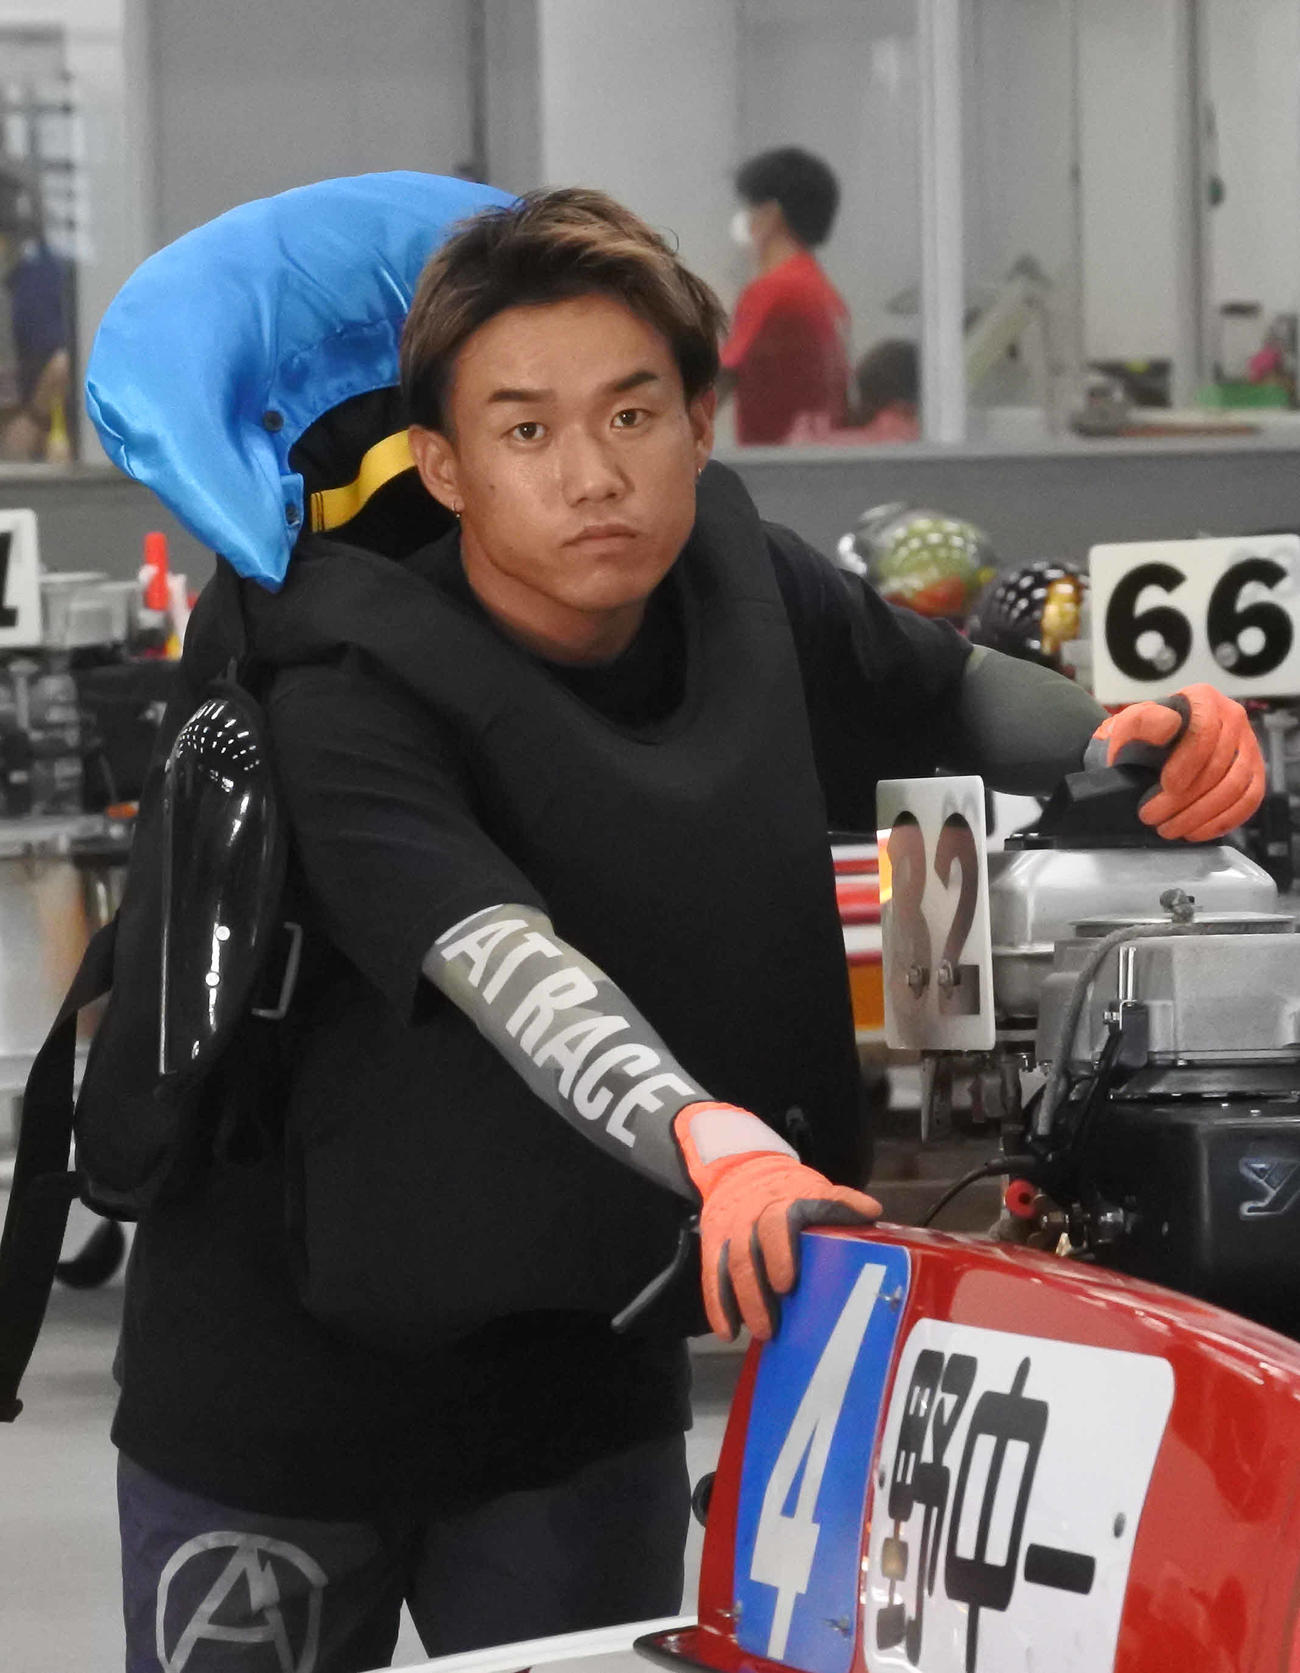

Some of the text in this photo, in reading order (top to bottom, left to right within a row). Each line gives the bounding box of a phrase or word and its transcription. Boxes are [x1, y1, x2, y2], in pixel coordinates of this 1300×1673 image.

[1105, 558, 1294, 681] 66
[434, 904, 697, 1148] AT RACE
[750, 1263, 887, 1660] 4
